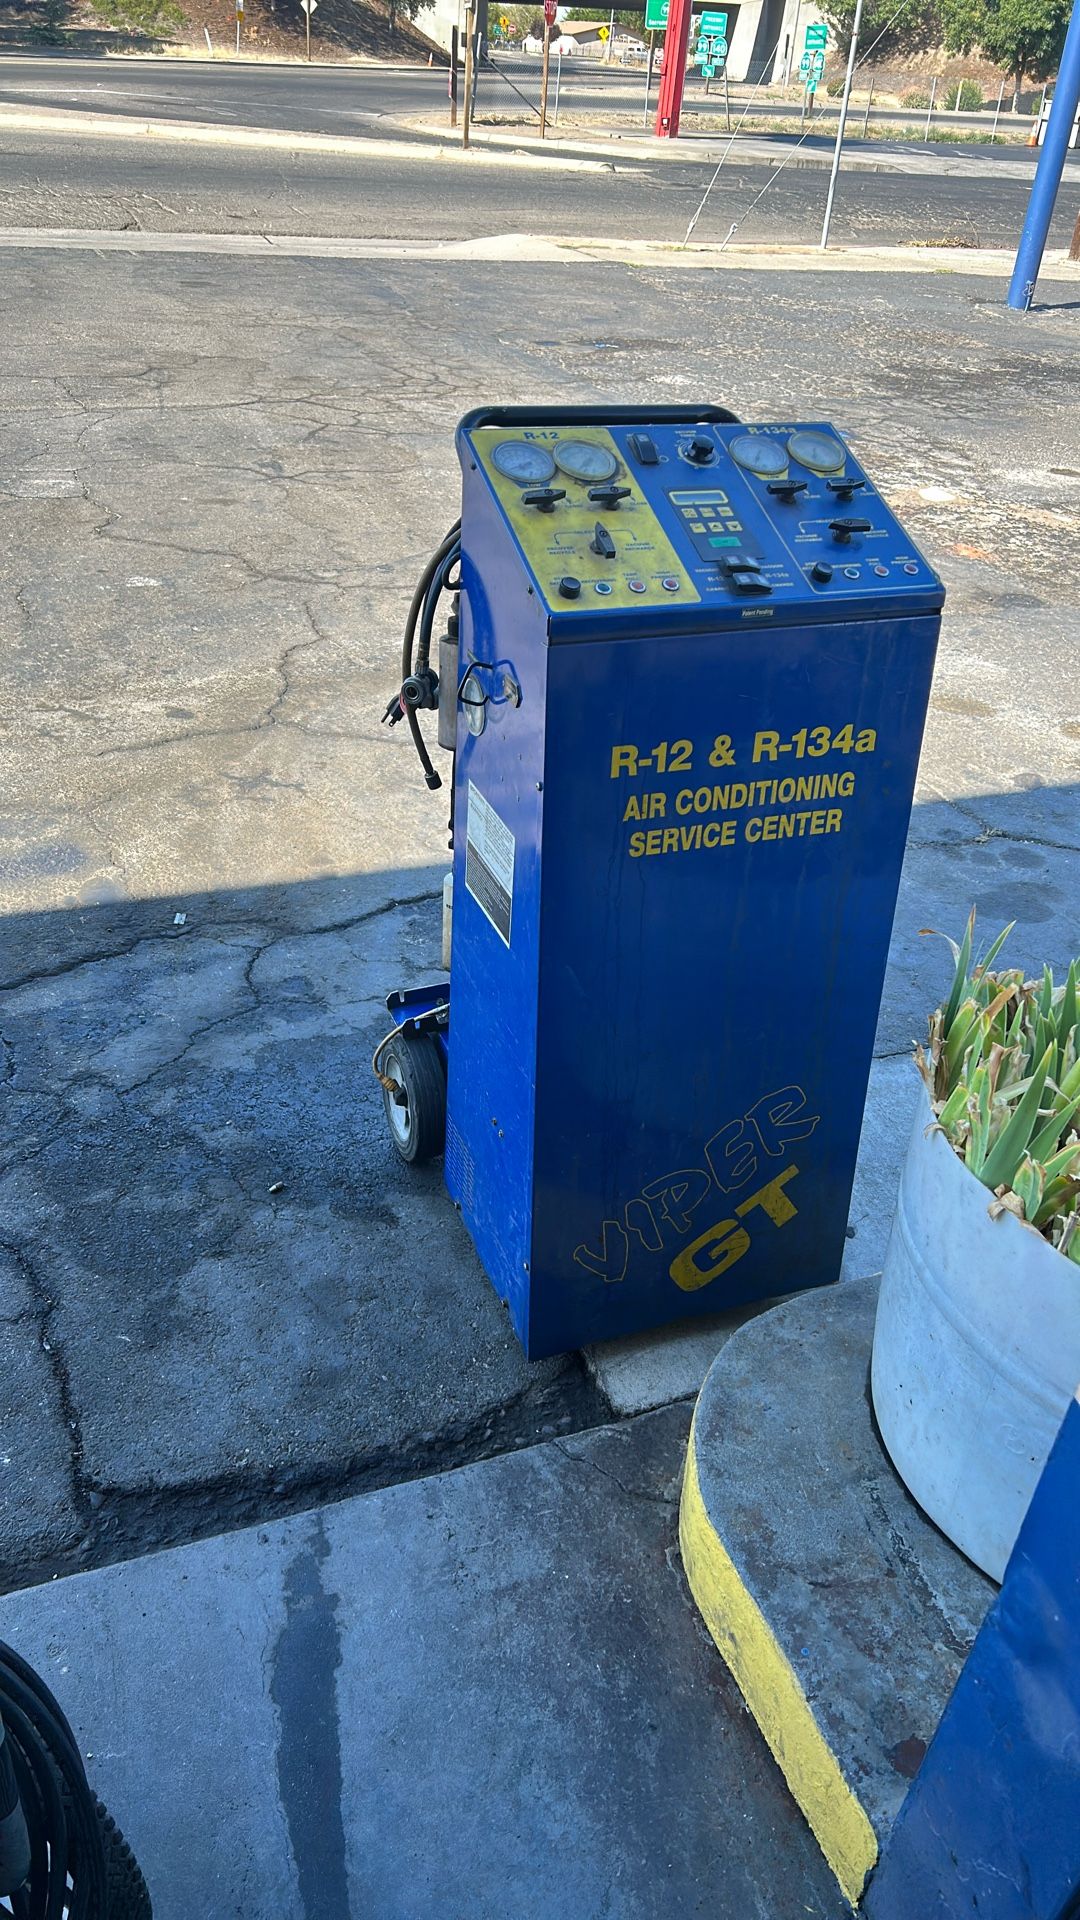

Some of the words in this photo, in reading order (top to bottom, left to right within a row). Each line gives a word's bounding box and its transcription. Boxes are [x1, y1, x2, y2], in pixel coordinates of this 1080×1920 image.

[545, 0, 557, 15] STOP
[698, 42, 707, 52] 99
[523, 432, 560, 440] R-12
[756, 608, 774, 616] Pending
[609, 739, 694, 779] R-12
[708, 734, 736, 767] &
[752, 724, 877, 764] R-134a
[623, 791, 667, 822] AIR
[675, 771, 855, 816] CONDITIONING
[629, 820, 737, 858] SERVICE
[745, 808, 843, 843] CENTER
[573, 1085, 820, 1282] VIPER
[669, 1163, 800, 1292] GT
